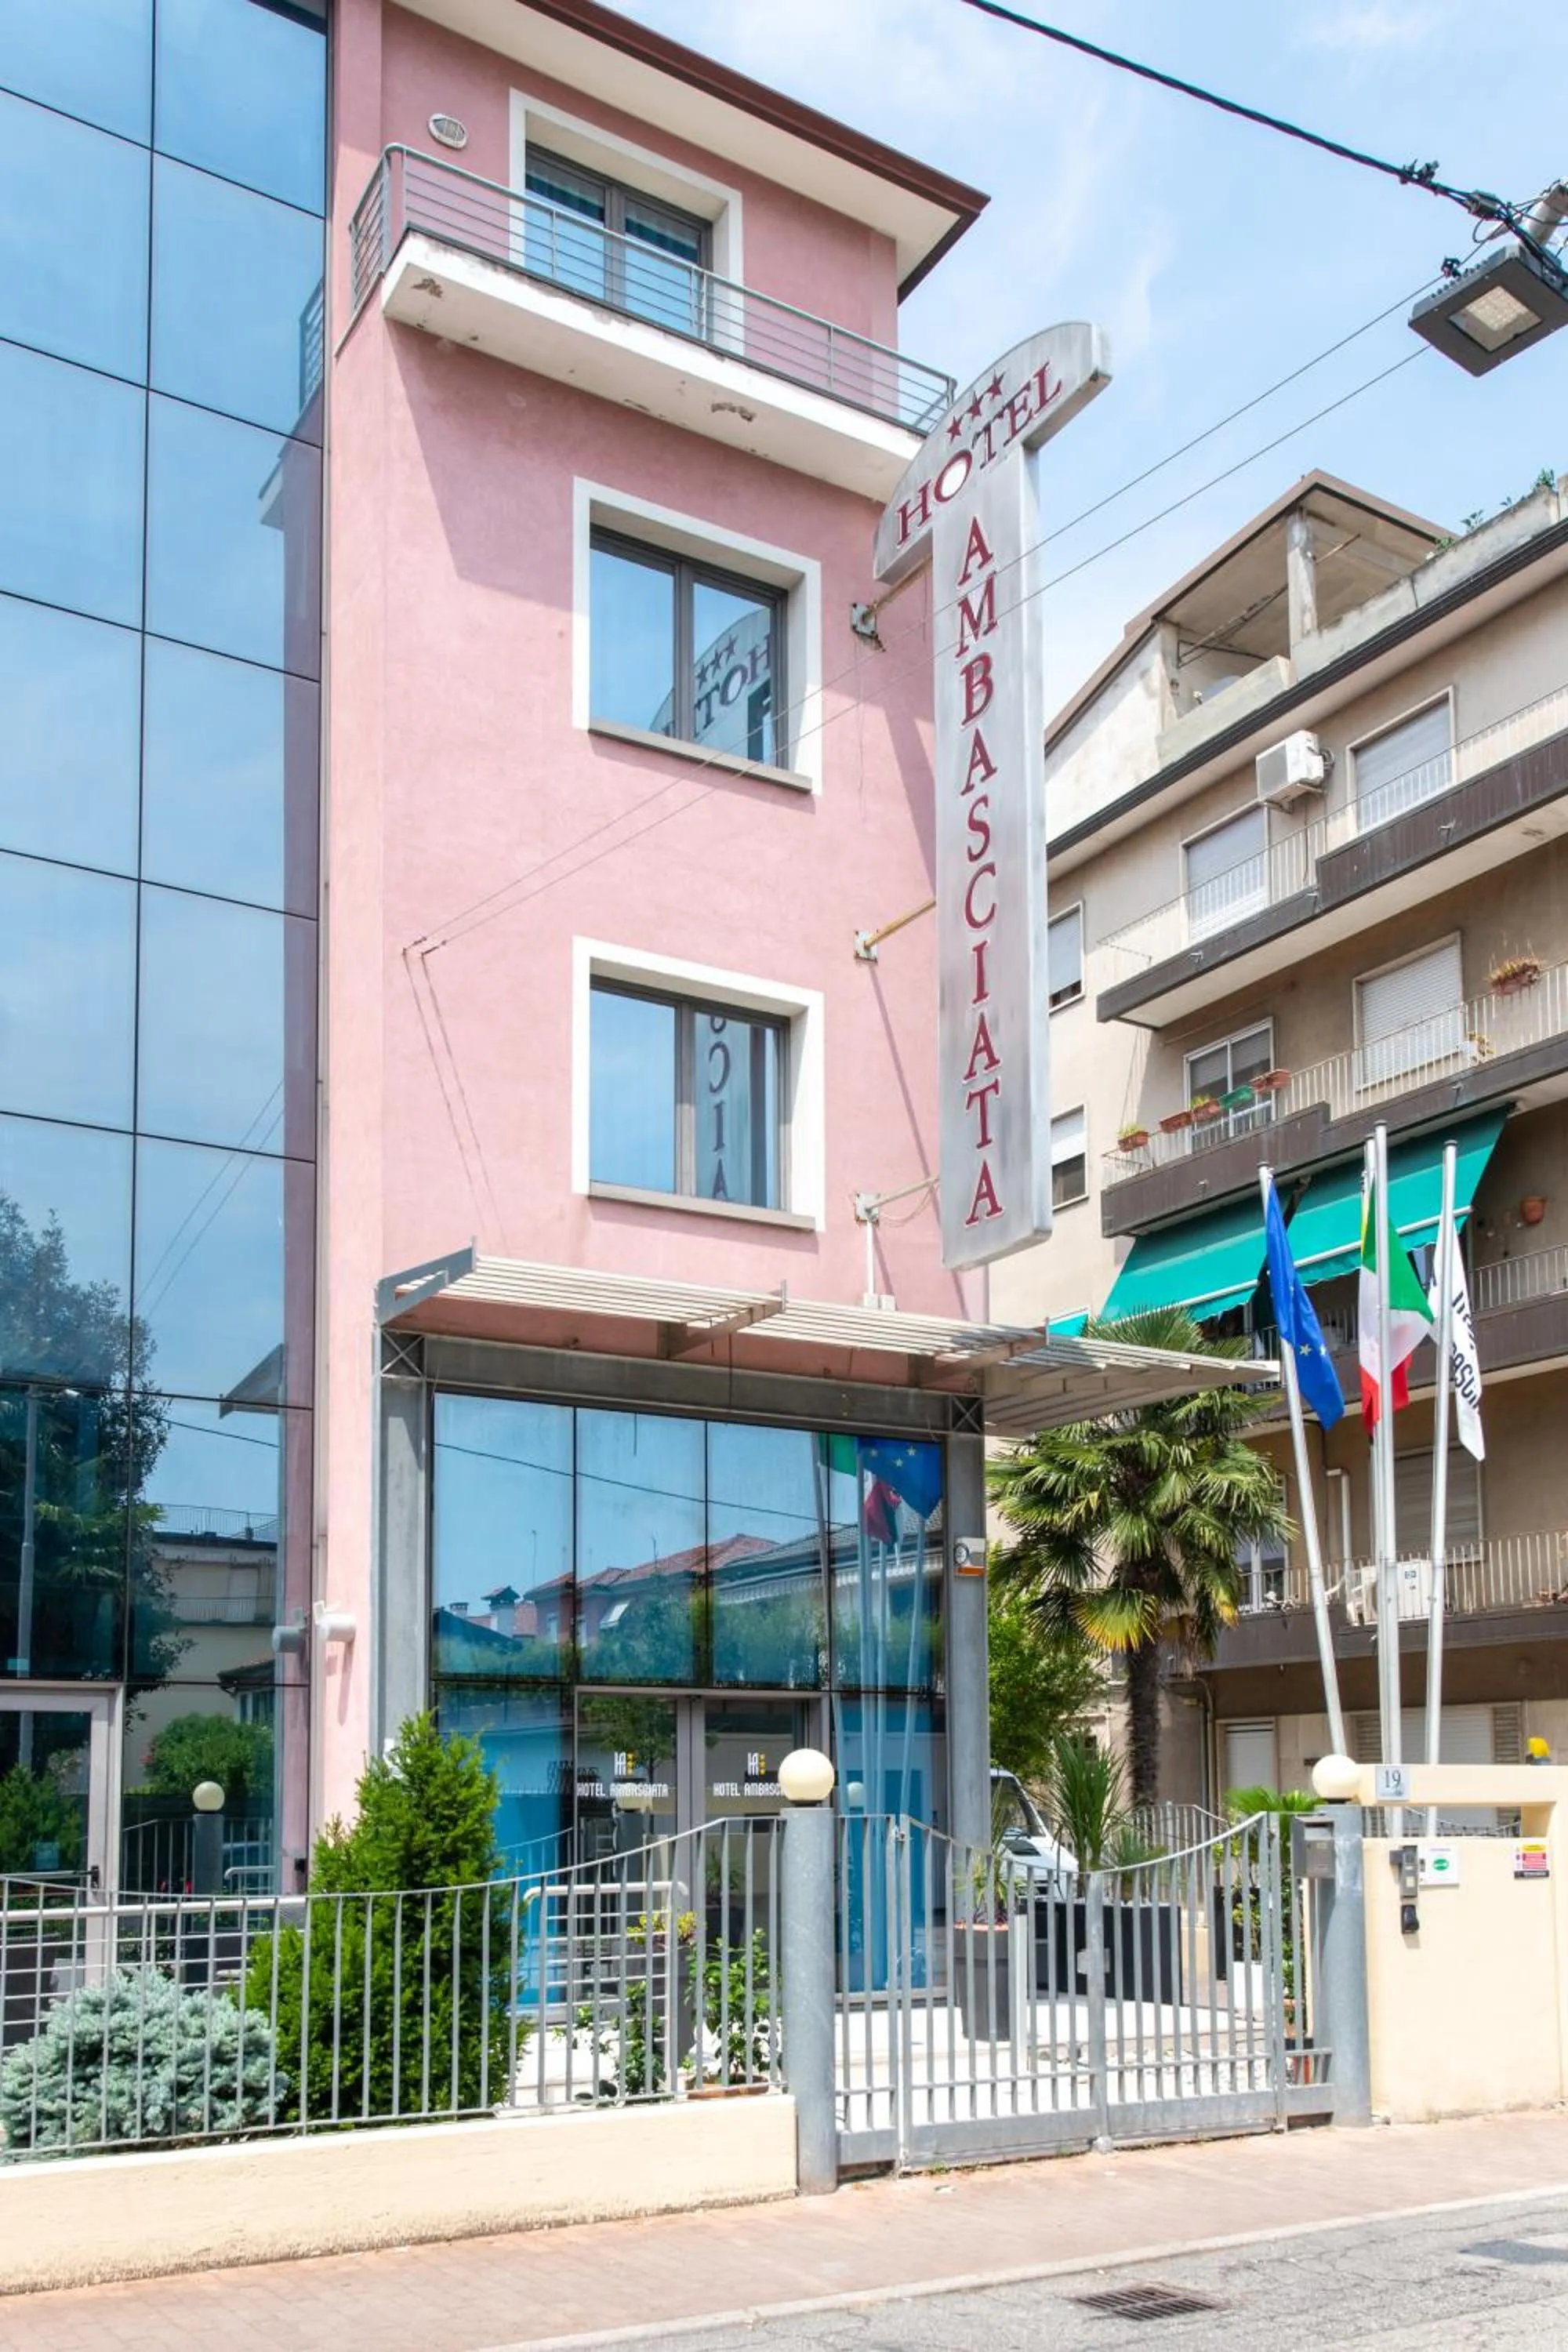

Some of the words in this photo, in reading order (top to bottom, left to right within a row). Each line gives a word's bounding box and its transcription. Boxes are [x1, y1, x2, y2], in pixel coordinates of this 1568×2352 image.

[896, 360, 1062, 546] HOTEL
[955, 515, 1003, 1226] AMBASCIATA
[1385, 1769, 1401, 1788] 19
[577, 1782, 606, 1797] HOTEL
[713, 1782, 741, 1797] HOTEL
